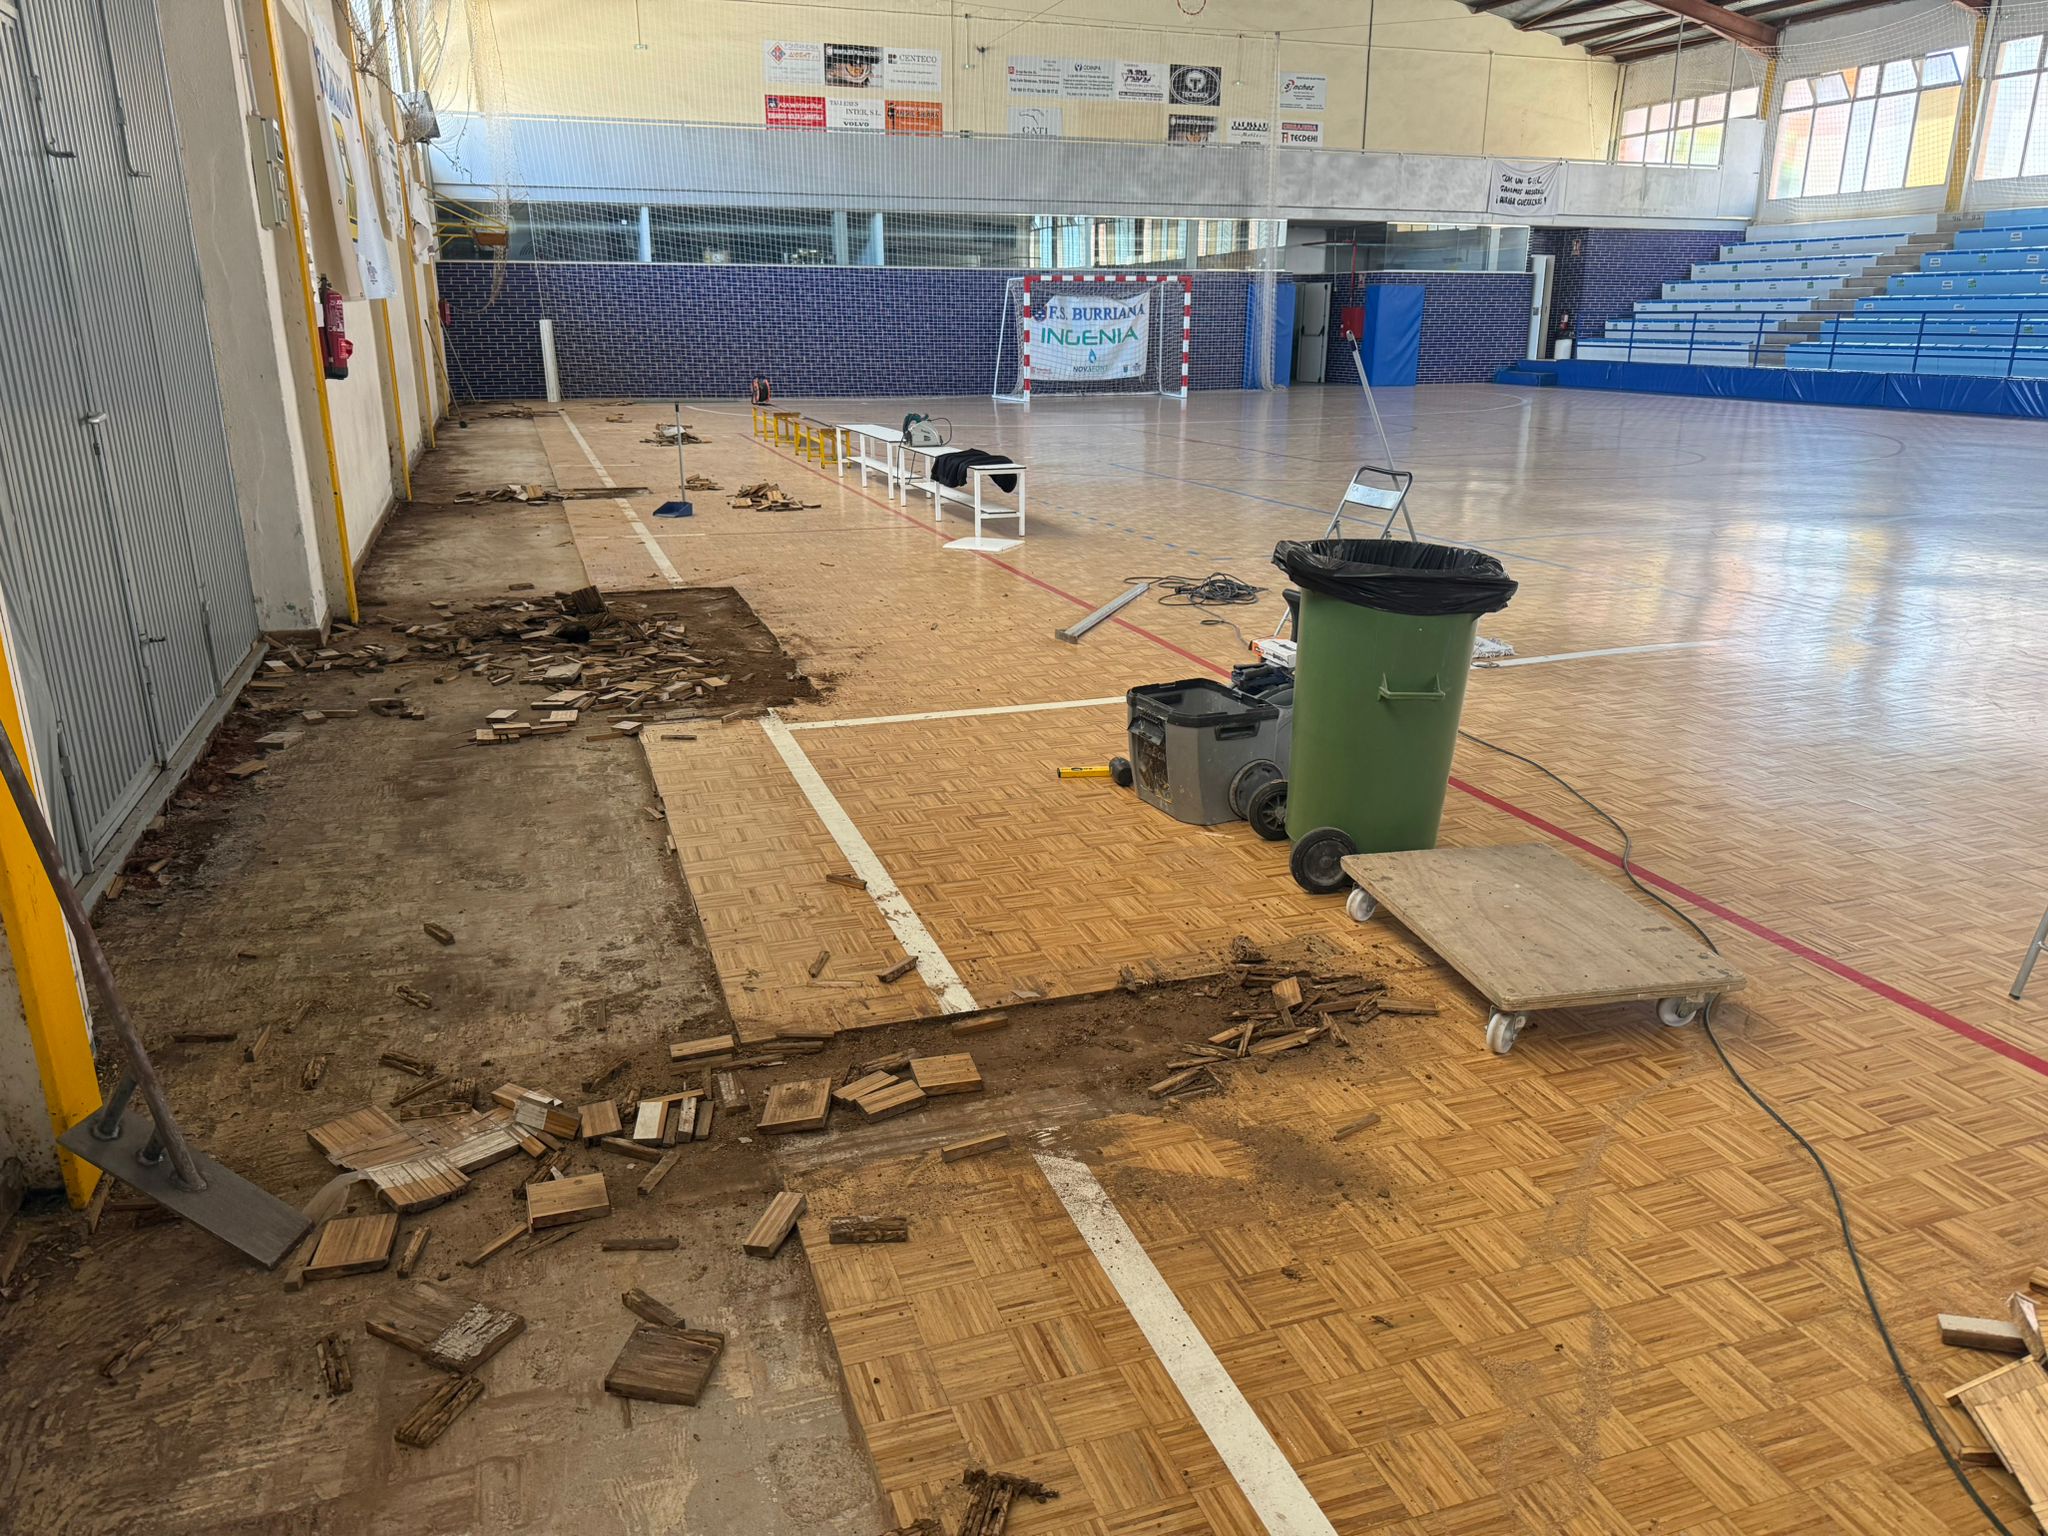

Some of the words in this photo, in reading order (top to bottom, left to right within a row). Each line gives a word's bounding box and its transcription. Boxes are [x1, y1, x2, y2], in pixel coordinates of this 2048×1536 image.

[899, 54, 937, 63] CENTECO
[1022, 126, 1048, 134] CATI
[1049, 306, 1067, 320] F.S.
[1072, 303, 1145, 321] BURRIANA
[1041, 326, 1138, 346] INGENIA
